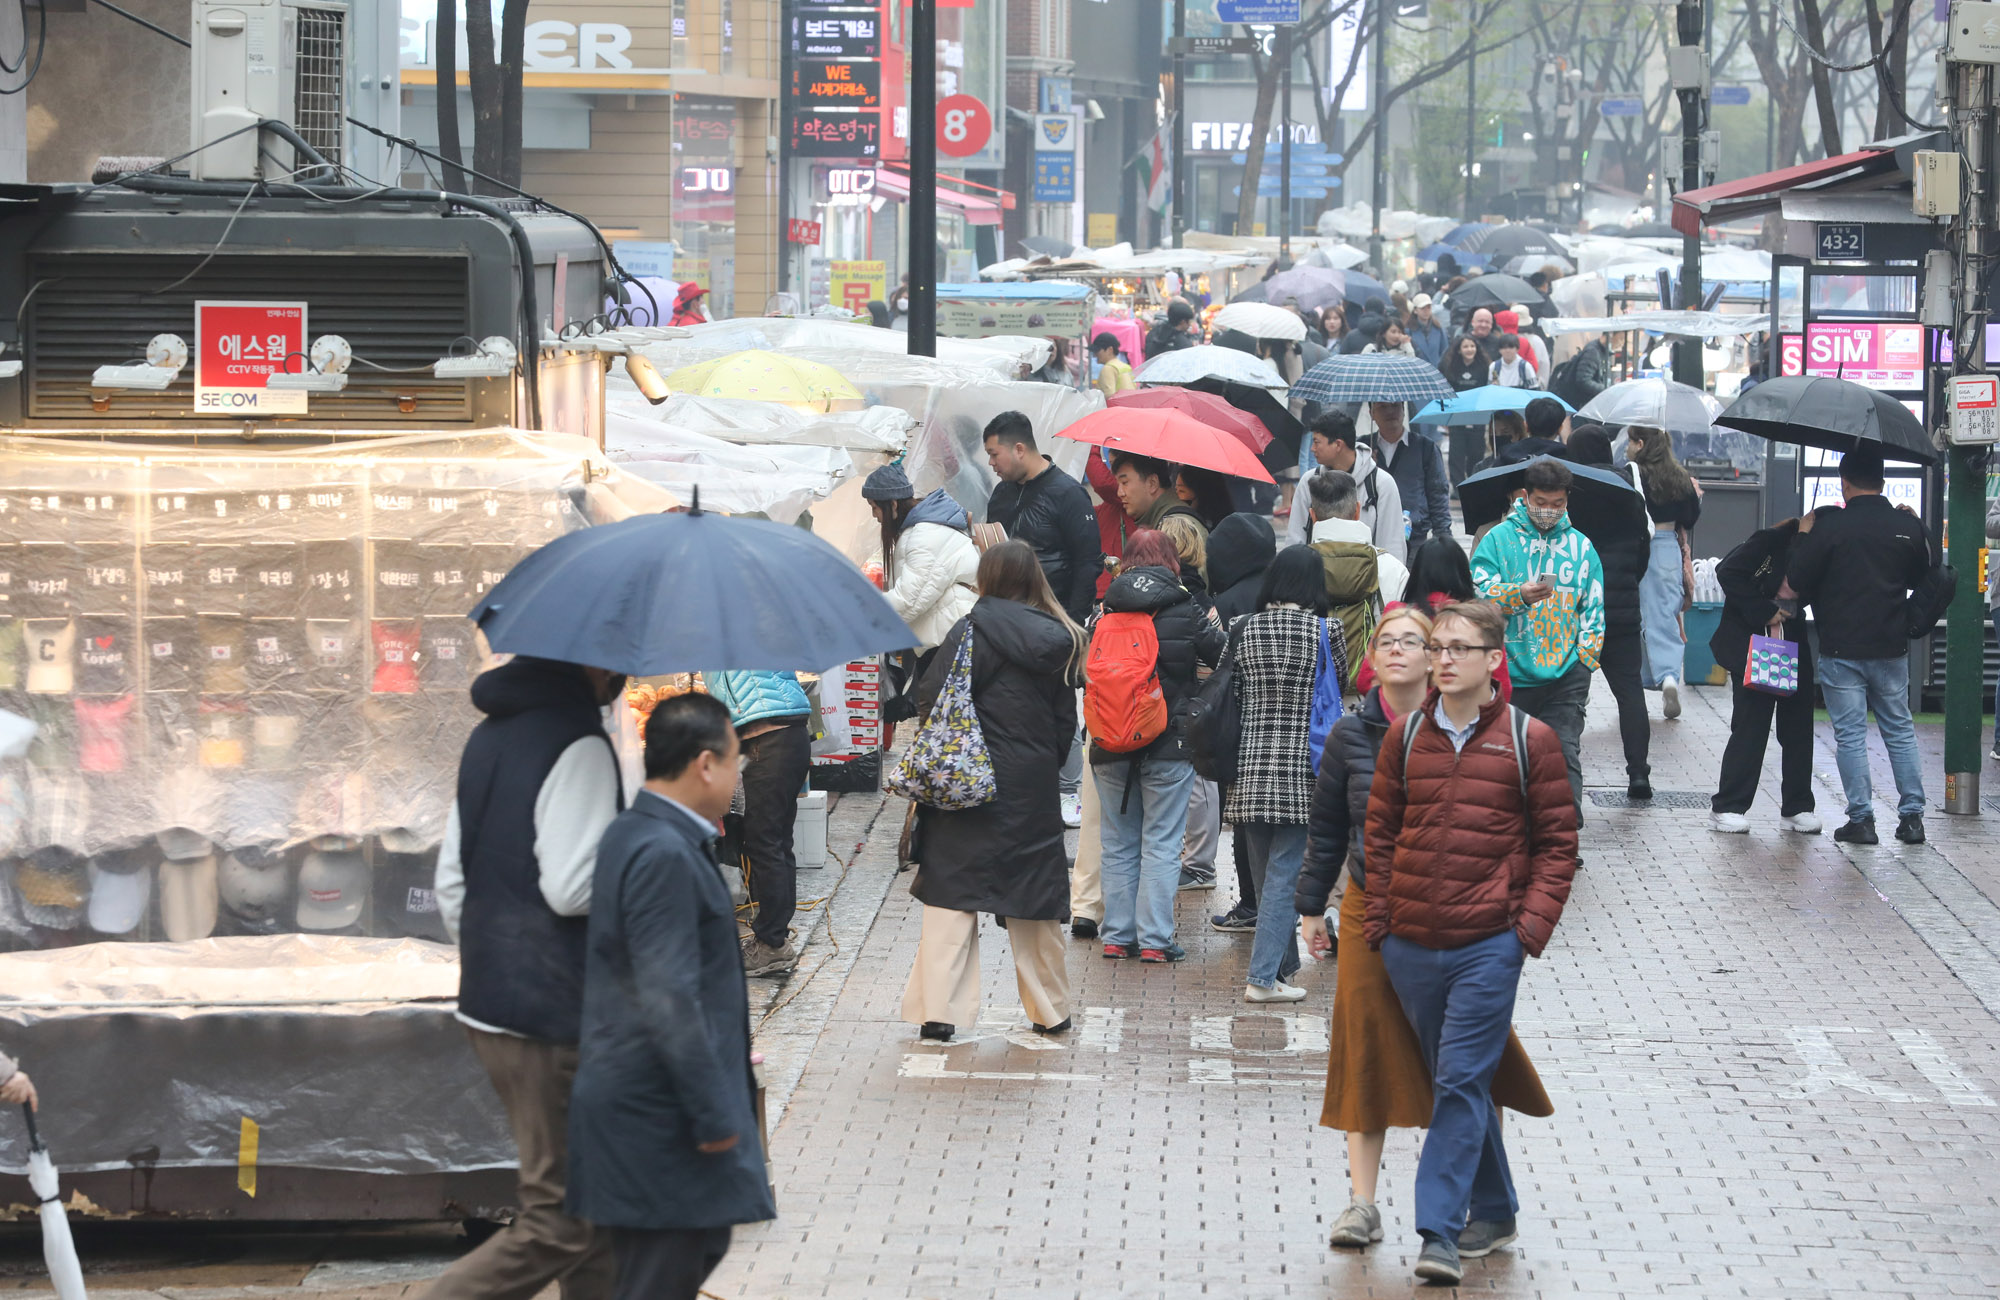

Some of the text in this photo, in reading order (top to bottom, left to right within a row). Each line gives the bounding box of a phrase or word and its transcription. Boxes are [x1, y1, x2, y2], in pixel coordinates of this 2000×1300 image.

[805, 20, 874, 38] 보드게임
[806, 45, 843, 53] MONACO
[825, 65, 851, 80] WE
[809, 82, 867, 96] 시계거래소
[802, 118, 876, 141] 약손명가
[863, 145, 876, 154] 5F
[1822, 235, 1859, 249] 43-2
[852, 272, 884, 281] Massage
[266, 310, 286, 318] 언제나
[218, 334, 287, 361] 에스원
[1810, 335, 1869, 363] SIM
[227, 365, 276, 374] CCTV 작동중
[201, 393, 257, 407] SECOM
[1811, 483, 1843, 497] BES
[257, 494, 292, 510] 아들
[428, 497, 458, 514] 대박
[208, 567, 239, 583] 친구
[259, 571, 293, 586] 외국인
[433, 570, 464, 586] 최고
[39, 639, 55, 661] C
[82, 652, 122, 665] Korea
